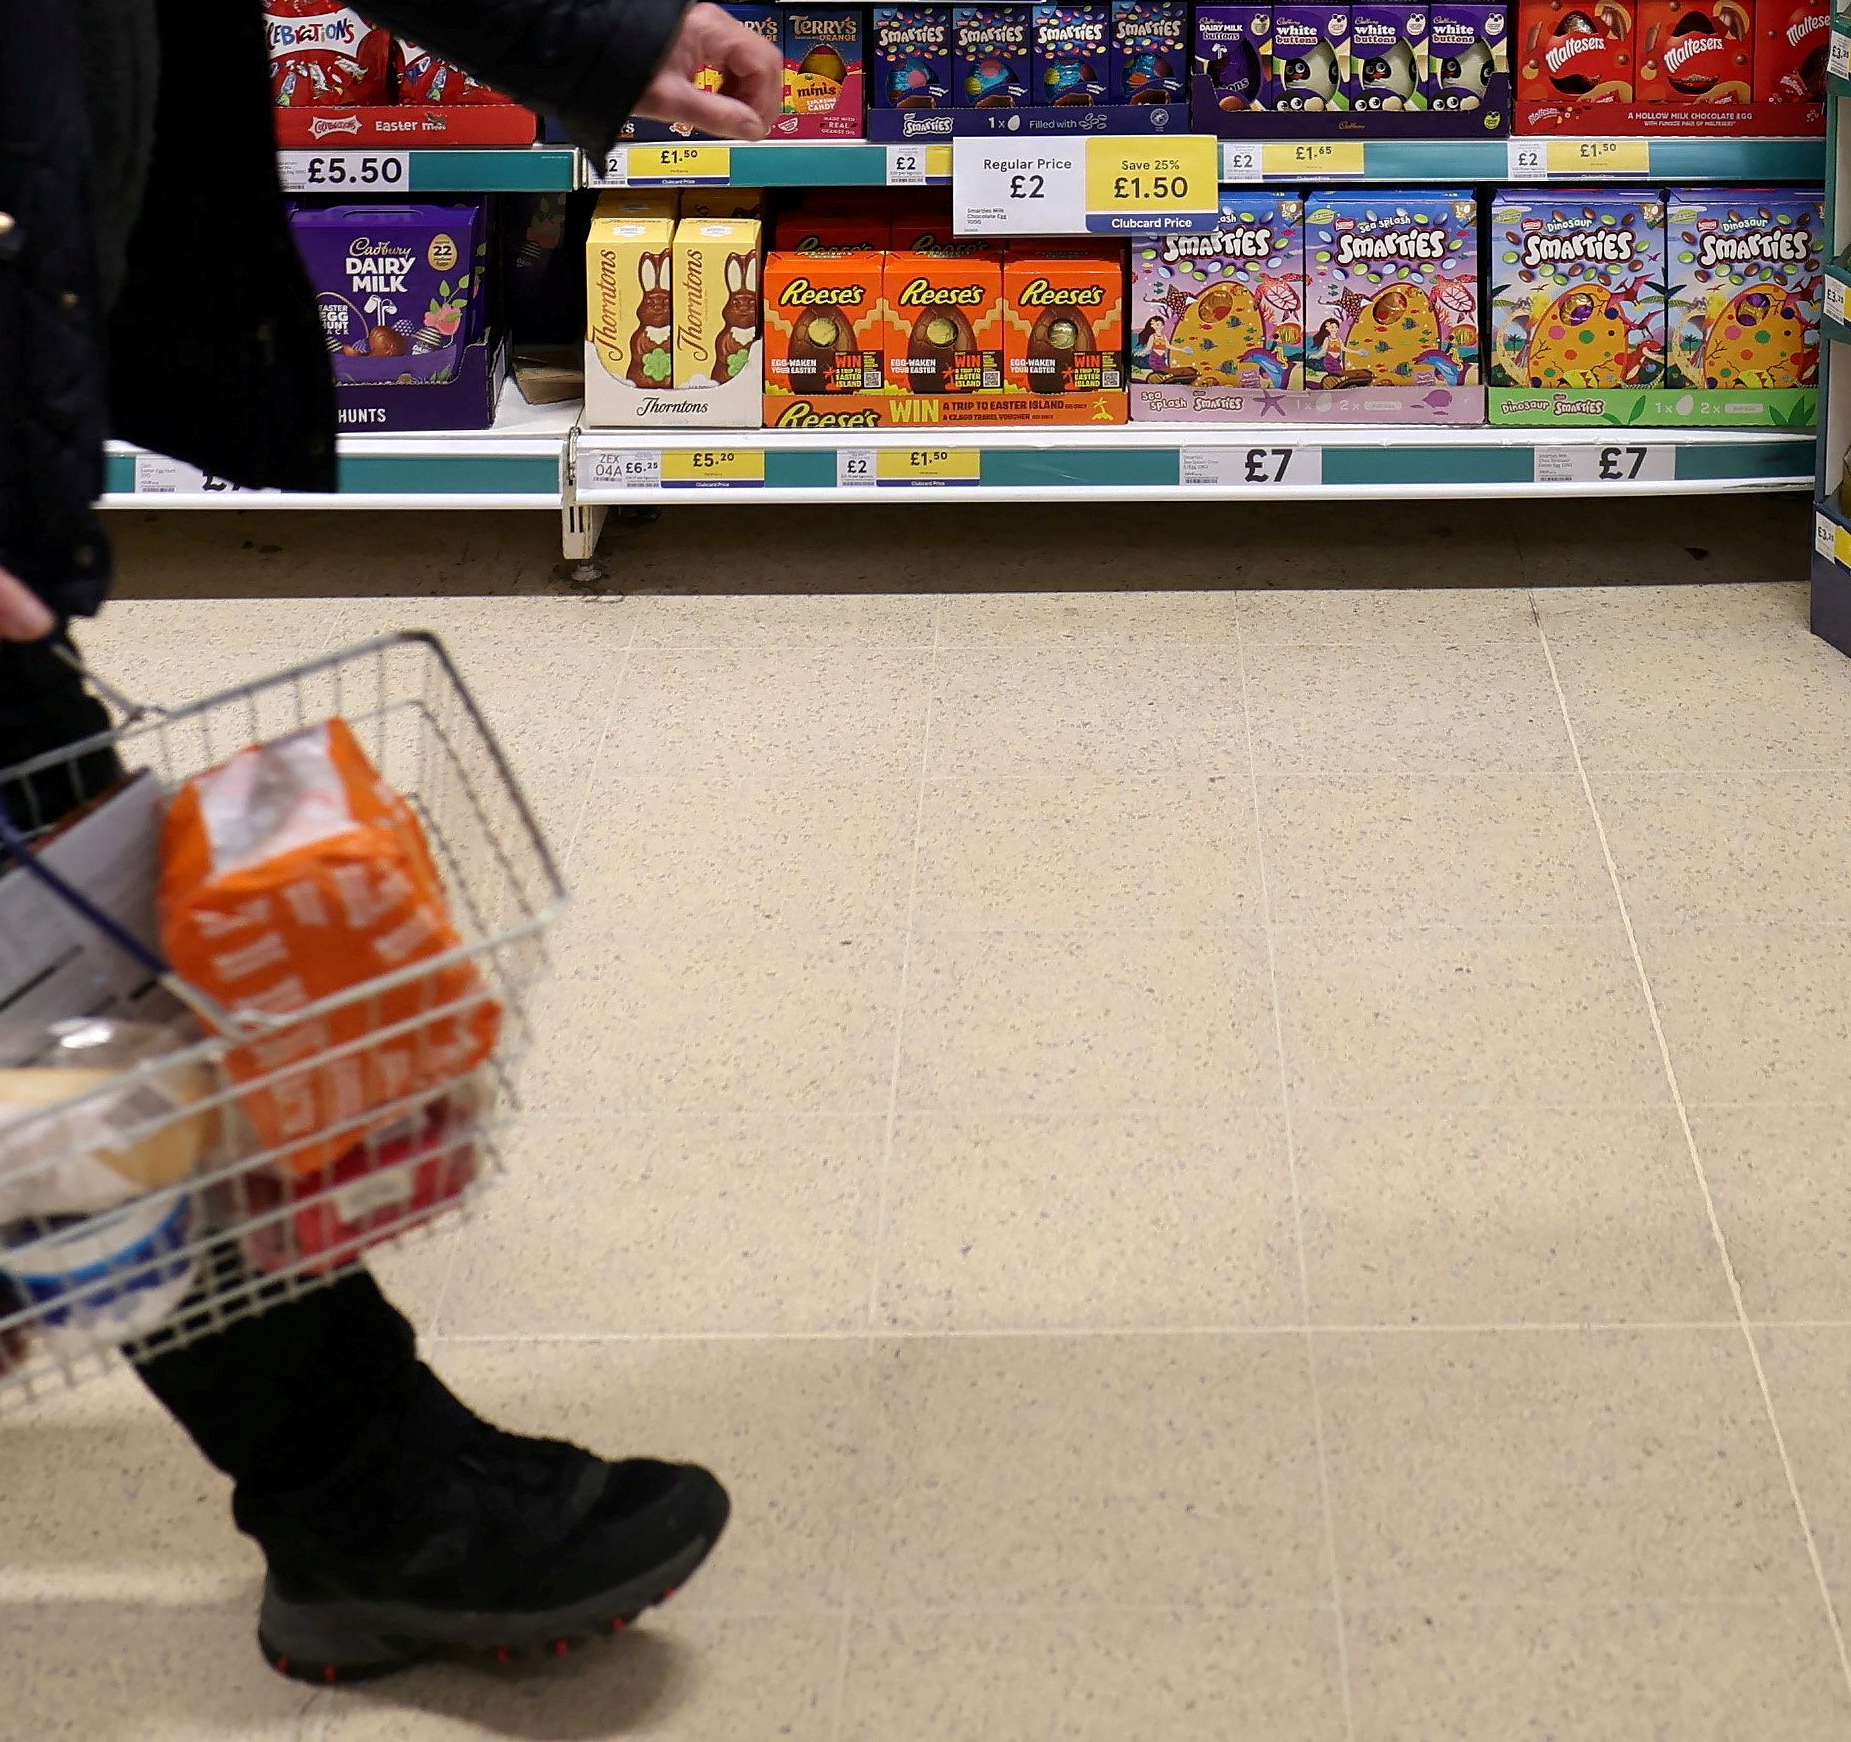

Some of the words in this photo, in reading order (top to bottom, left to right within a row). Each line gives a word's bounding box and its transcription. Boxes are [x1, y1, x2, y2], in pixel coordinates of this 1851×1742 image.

[307, 156, 402, 185] £5.50
[983, 158, 1035, 172] Regular
[1039, 158, 1072, 170] Price
[1010, 174, 1046, 200] £2
[1113, 175, 1188, 200] £1.50
[345, 257, 415, 277] DAIRY
[352, 275, 407, 294] MILK
[638, 398, 708, 416] Thorntons
[1244, 449, 1294, 483] £7
